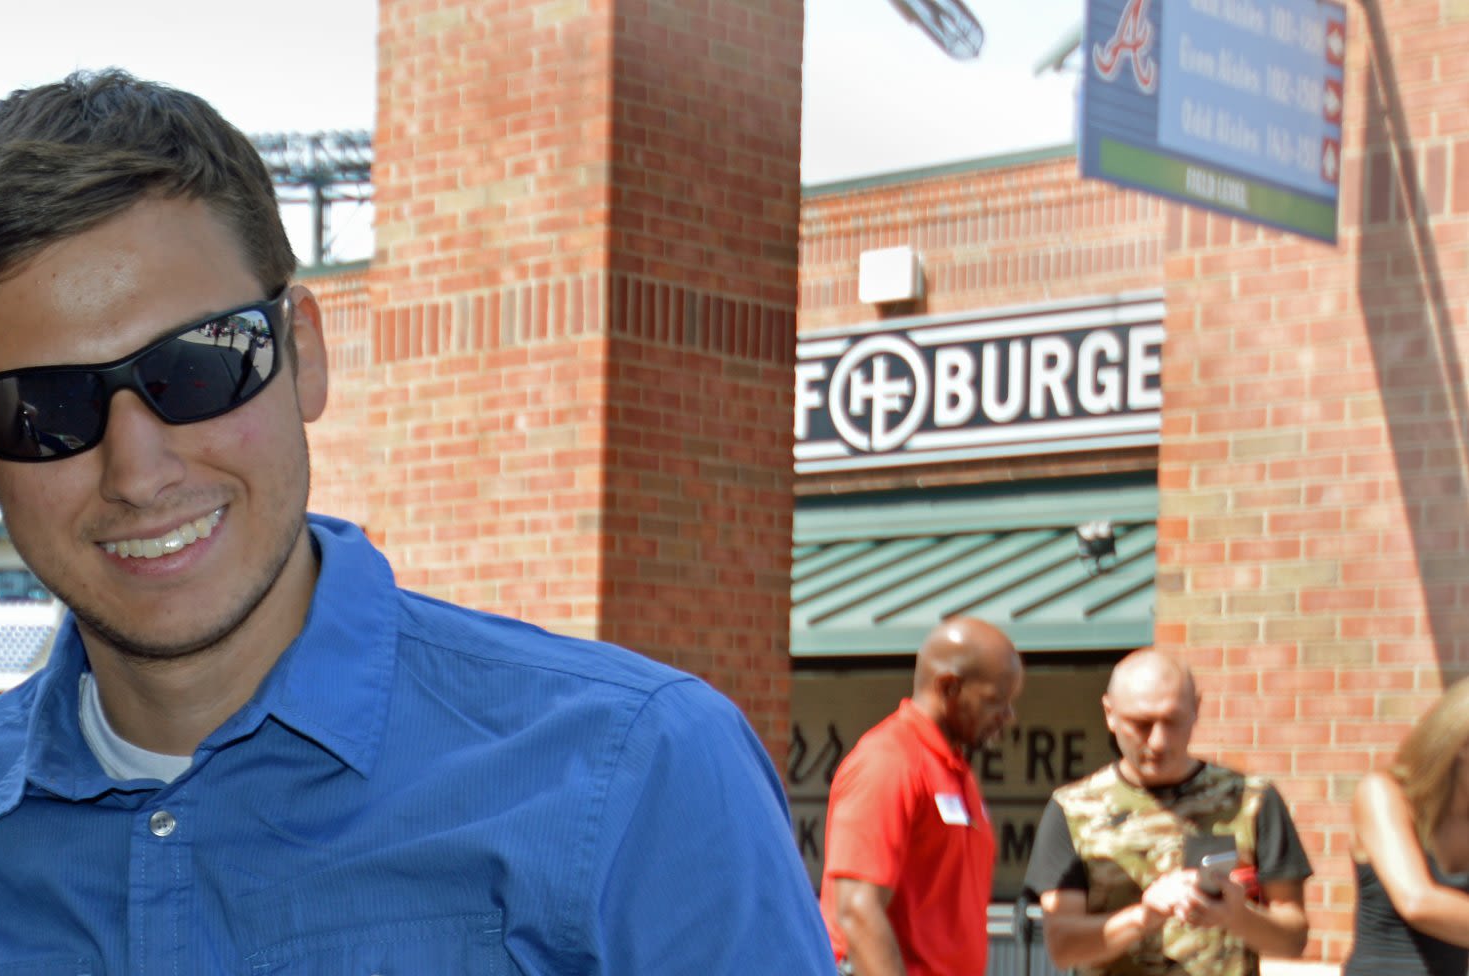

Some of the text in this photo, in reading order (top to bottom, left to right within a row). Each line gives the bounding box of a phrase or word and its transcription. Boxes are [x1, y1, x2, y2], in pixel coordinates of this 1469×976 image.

[1218, 46, 1261, 93] Aisles
[1182, 97, 1213, 140] Odd
[1216, 107, 1260, 153] Aisles
[1186, 166, 1248, 209] FIELD LEVEL
[933, 325, 1163, 428] BURGE
[962, 730, 1085, 784] E'RE
